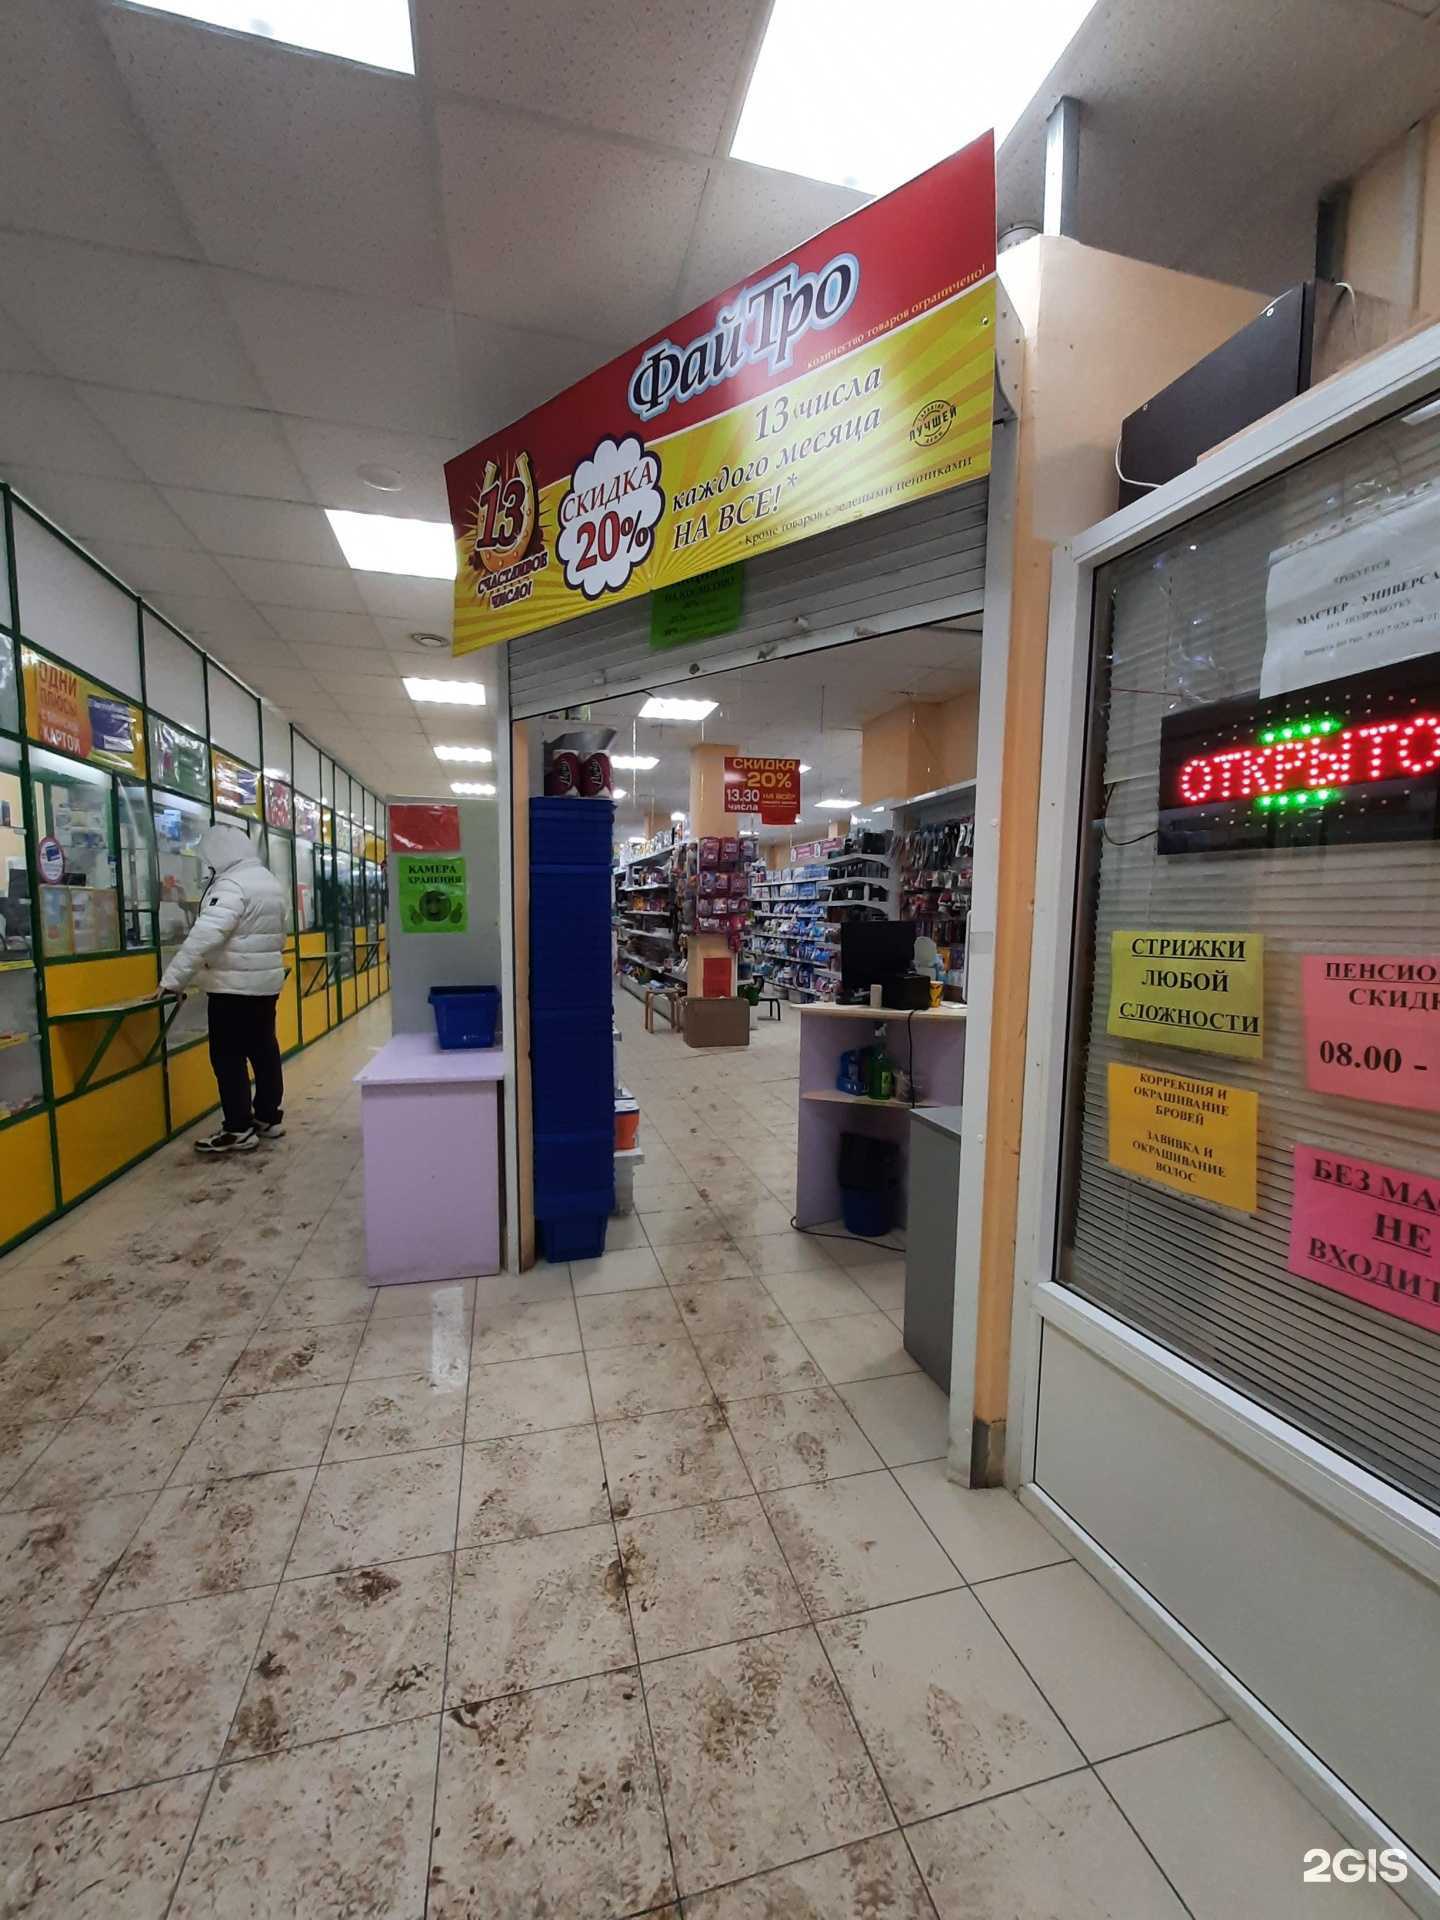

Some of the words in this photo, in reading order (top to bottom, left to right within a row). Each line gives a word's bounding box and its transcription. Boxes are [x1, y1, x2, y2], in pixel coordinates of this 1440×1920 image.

[807, 332, 864, 368] количество
[866, 309, 909, 339] товаров
[911, 264, 986, 316] ограничено!
[755, 395, 789, 442] 13
[798, 367, 881, 419] числа
[672, 455, 770, 513] каждого
[775, 407, 881, 470] месяца
[895, 456, 974, 492] ценниками
[560, 461, 653, 523] СКИДКА
[476, 477, 528, 550] 13
[575, 509, 650, 573] 20%
[673, 513, 709, 551] НА
[1296, 601, 1349, 625] МАСТЕР
[732, 758, 796, 771] СКИДКА
[1180, 716, 1440, 802] ОТКРЫТО
[408, 864, 457, 874] КАМЕРА
[408, 875, 462, 885] ХРАНЕНИЯ
[1131, 938, 1246, 959] СТРИЖКИ
[1141, 969, 1230, 992] ЛЮБОЙ
[1325, 962, 1440, 982] ПЕНСИО
[1119, 1001, 1260, 1033] СЛОЖНОСТИ
[1320, 1040, 1402, 1073] 08.00
[1133, 1085, 1230, 1117] ОКРАШИВАНИЕ
[1140, 1072, 1214, 1098] КОРРЕКЦИЯ
[1217, 1089, 1227, 1101] И
[1155, 1104, 1204, 1127] БРОВЕЙ
[1132, 1140, 1226, 1178] ОКРАШИВАНИЕ
[1146, 1128, 1200, 1156] ЗАВИВКА
[1203, 1147, 1214, 1160] И
[1155, 1161, 1196, 1183] ВОЛОС
[1314, 1158, 1371, 1192] БЕЗ
[1379, 1175, 1440, 1213] МА
[1373, 1212, 1432, 1253] НЕ
